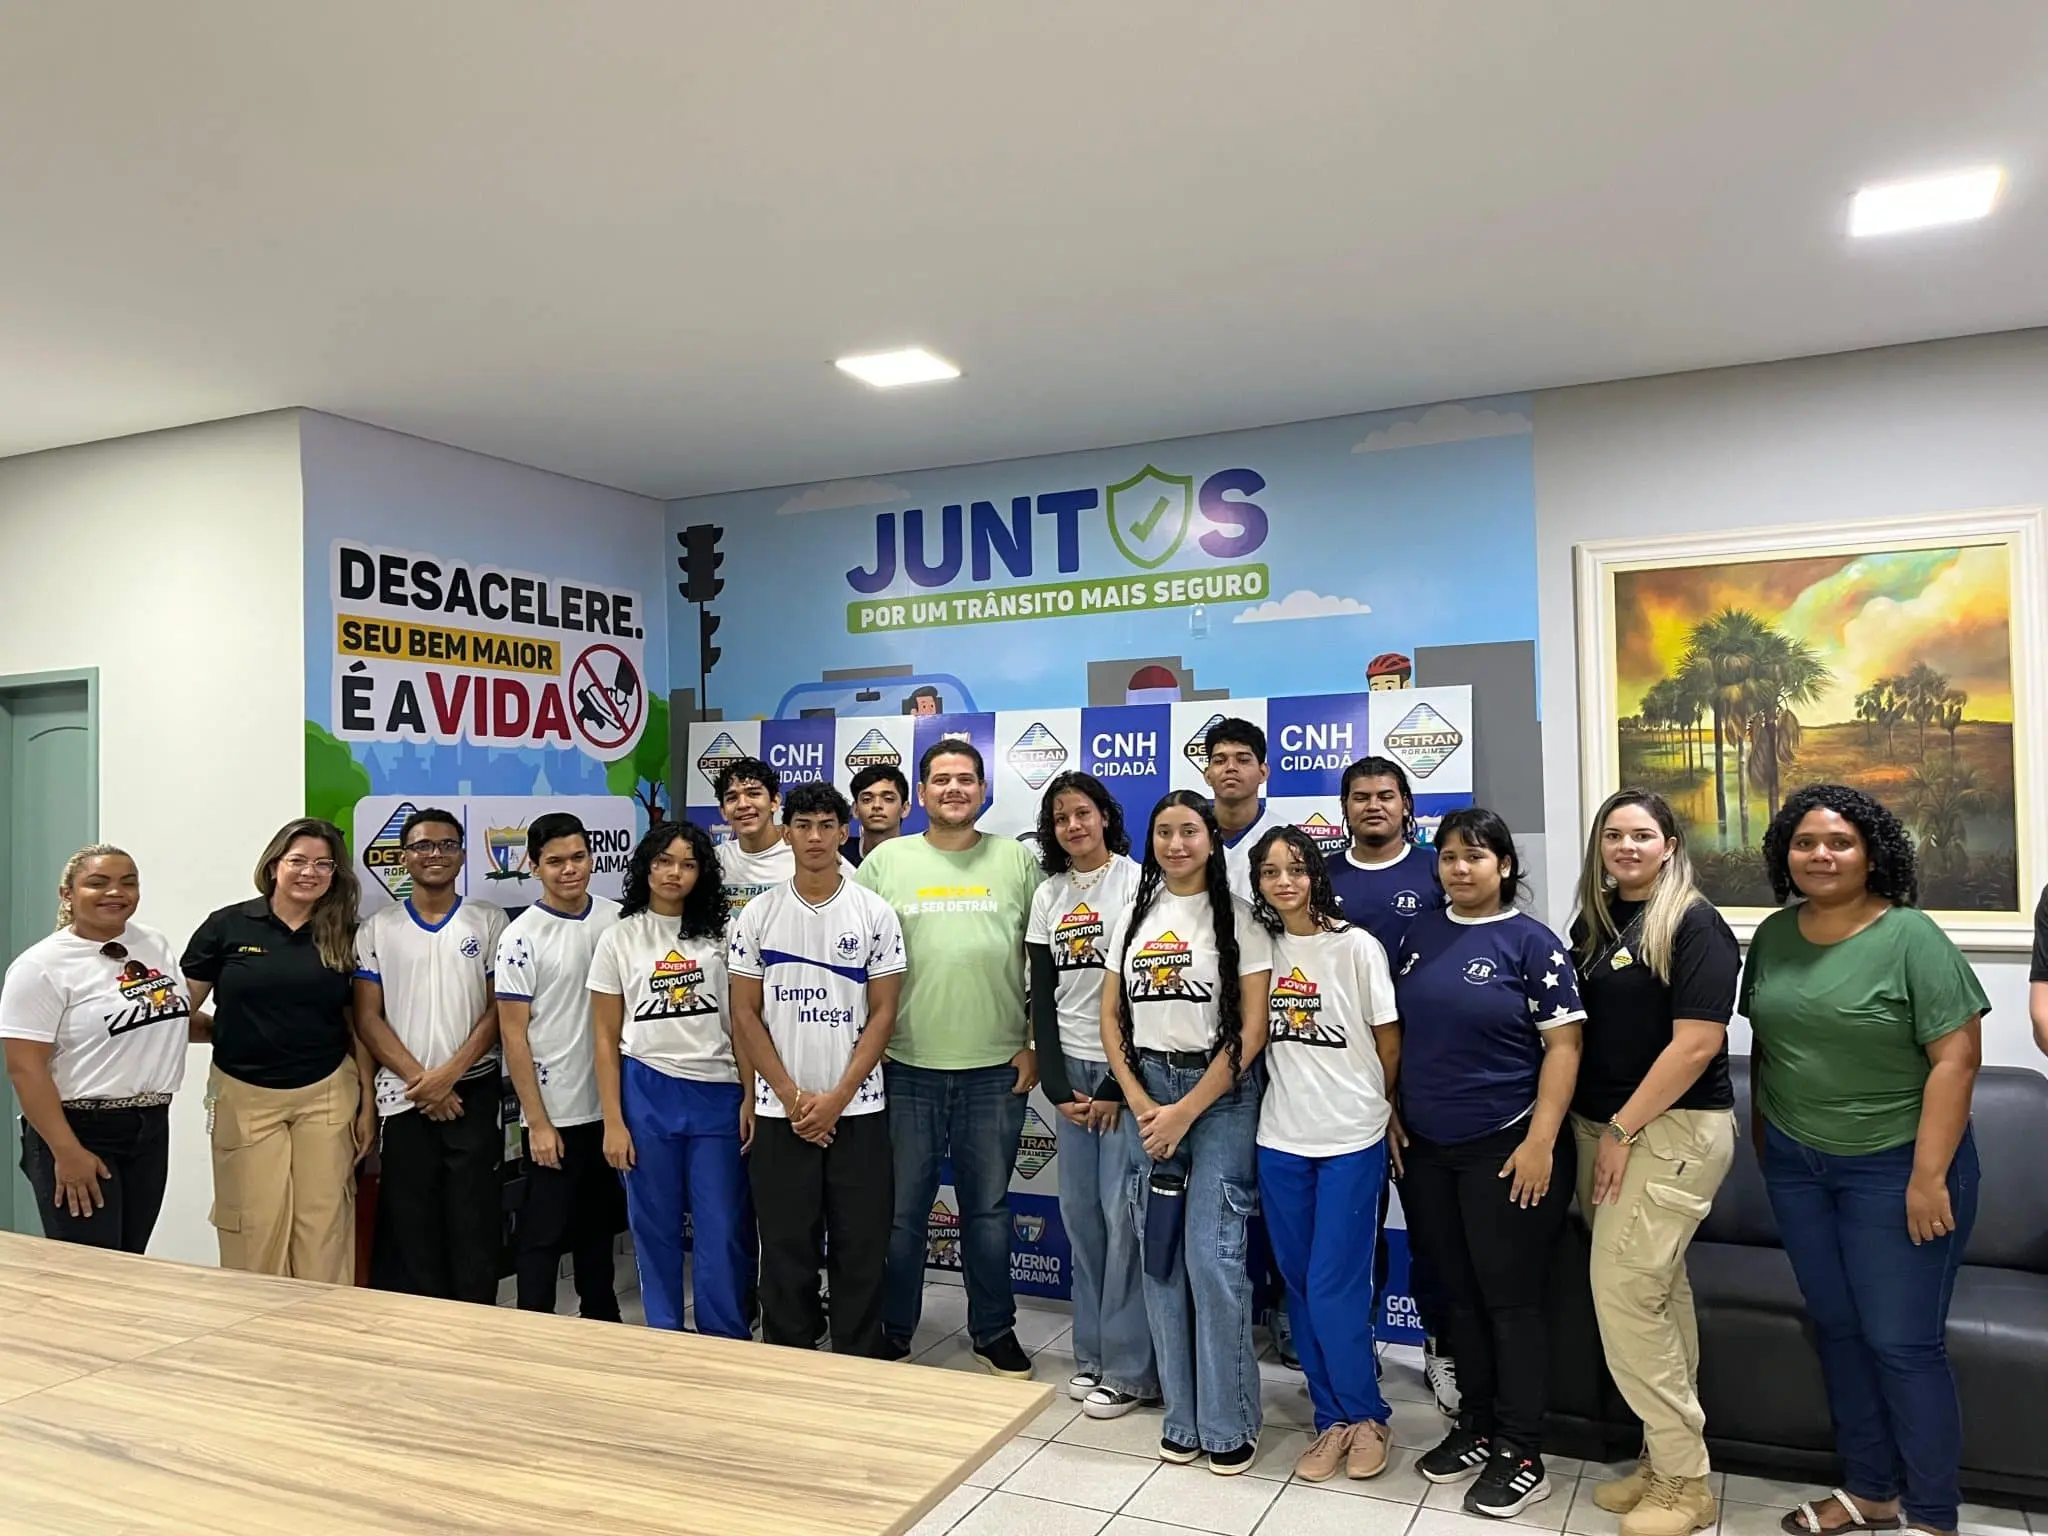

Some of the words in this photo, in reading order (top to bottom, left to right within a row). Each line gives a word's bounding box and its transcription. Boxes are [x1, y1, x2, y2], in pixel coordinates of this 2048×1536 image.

[339, 547, 644, 640] DESACELERE.
[861, 605, 906, 628] POR
[912, 601, 948, 625] UM
[952, 590, 1074, 620] TRÂNSITO
[1081, 583, 1147, 610] MAIS
[1153, 572, 1262, 604] SEGURO
[342, 620, 402, 655] SEU
[408, 629, 466, 662] BEM
[472, 637, 553, 670] MAIOR
[342, 660, 375, 731] É
[425, 671, 572, 741] VIDA
[1092, 731, 1157, 759] CNH
[1280, 722, 1354, 752] CNH
[1388, 733, 1459, 747] DETRAN
[769, 743, 823, 767] CNH
[847, 754, 899, 765] DETRAN
[1280, 751, 1353, 772] CIDADÃ
[779, 766, 824, 784] IDADÃ
[1092, 759, 1157, 778] CIDADÃ
[920, 901, 945, 913] SER
[1055, 924, 1102, 942] CONDUTOR
[658, 962, 688, 970] JOVEM
[1133, 953, 1191, 969] CONDUTOR
[652, 971, 703, 989] CONDUTOR
[770, 984, 828, 1006] Tempo
[798, 1005, 854, 1028] Integral
[928, 1212, 951, 1224] OVEM
[1010, 1252, 1061, 1272] VERNO
[1387, 1312, 1405, 1327] DE
